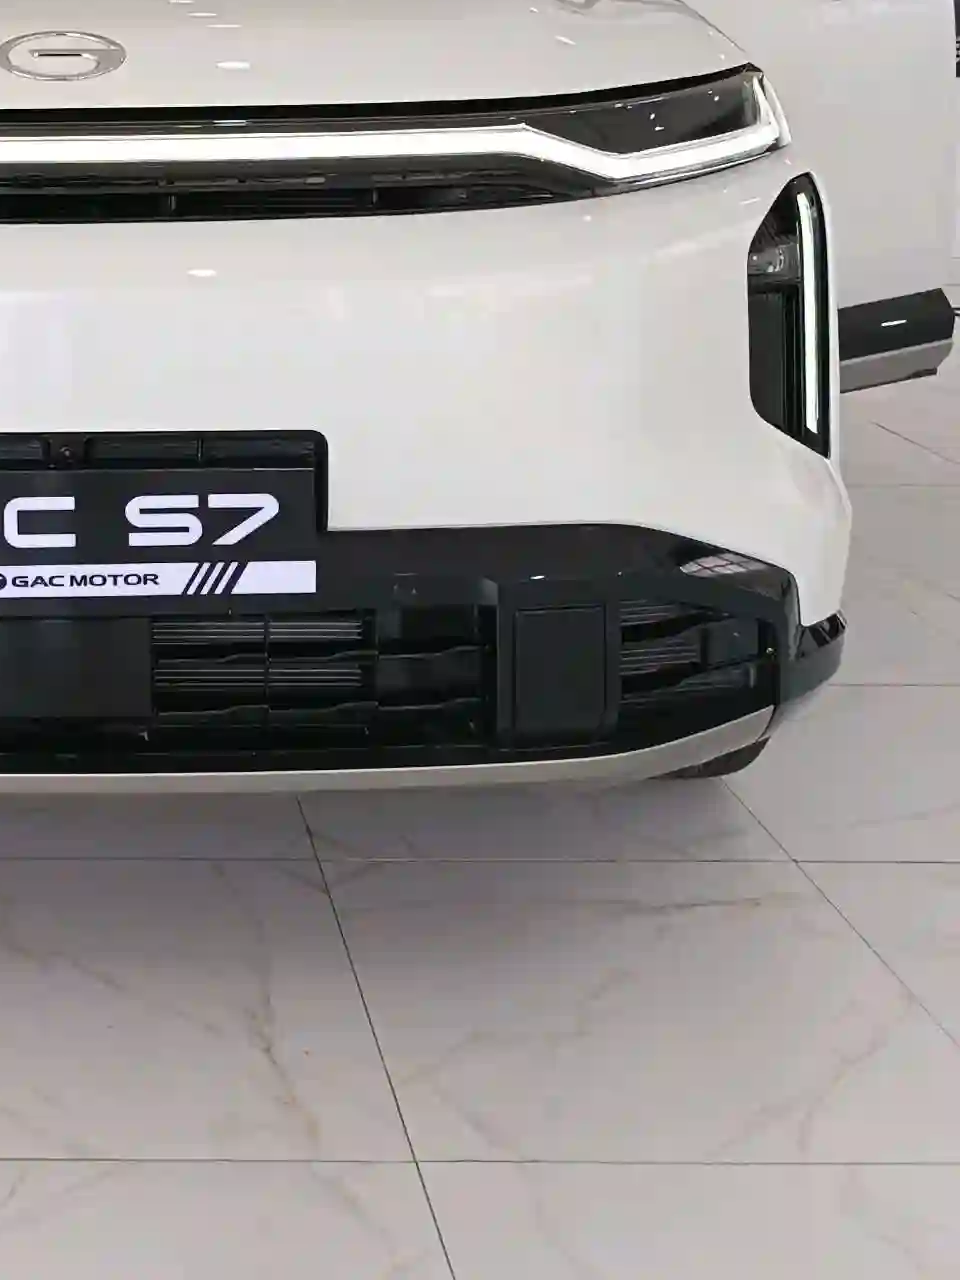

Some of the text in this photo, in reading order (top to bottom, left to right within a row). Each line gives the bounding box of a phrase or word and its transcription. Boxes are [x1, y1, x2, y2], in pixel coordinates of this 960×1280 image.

[124, 493, 280, 547] S7
[11, 573, 160, 588] GAC MOTOR
